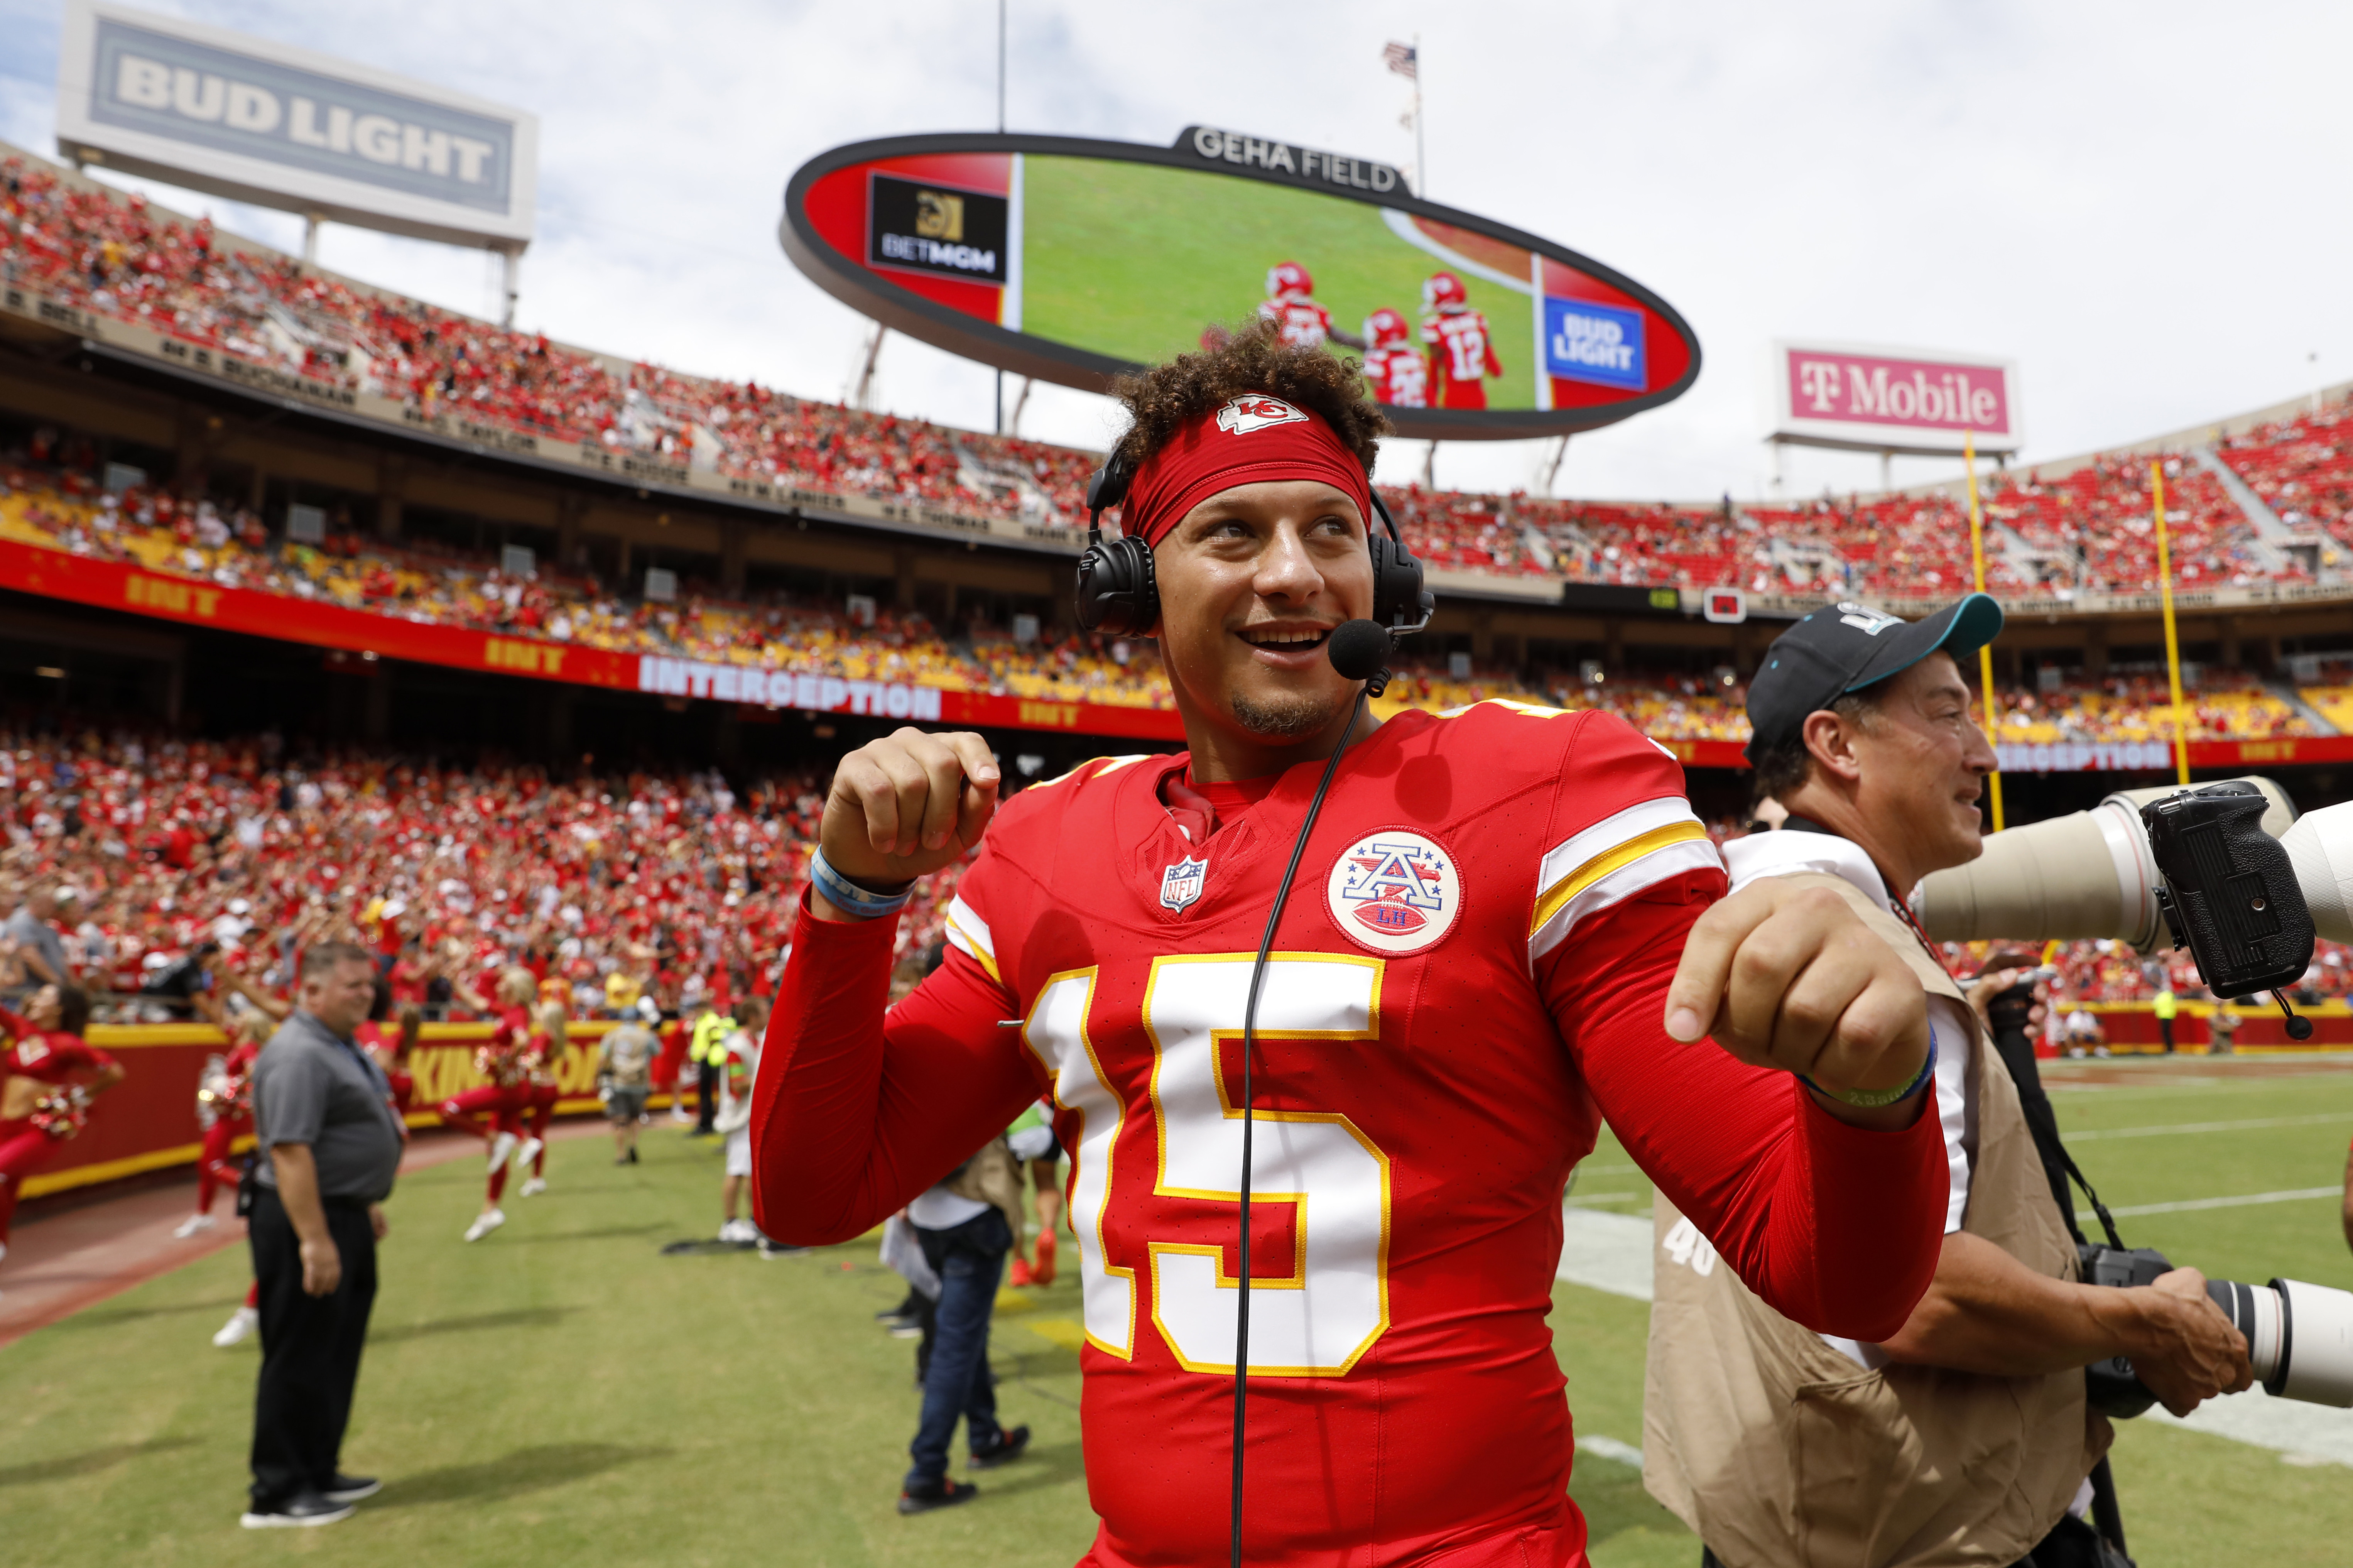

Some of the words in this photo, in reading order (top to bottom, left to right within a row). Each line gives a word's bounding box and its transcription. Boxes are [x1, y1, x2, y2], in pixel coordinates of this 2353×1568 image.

[117, 53, 281, 133] BUD
[288, 96, 493, 183] LIGHT
[1193, 128, 1296, 174] GEHA
[1302, 151, 1396, 193] FIELD
[882, 233, 995, 273] BETMGM
[1564, 312, 1623, 343] BUD
[1447, 331, 1485, 381] 12
[1553, 336, 1634, 373] LIGHT
[1238, 400, 1289, 419] KC
[126, 574, 223, 617] INT
[485, 637, 566, 674] INT
[639, 654, 941, 721] INTERCEPTION
[1019, 702, 1079, 726] INT
[1167, 879, 1194, 901] NFL
[1342, 843, 1442, 911] A
[1021, 951, 1390, 1377] 15
